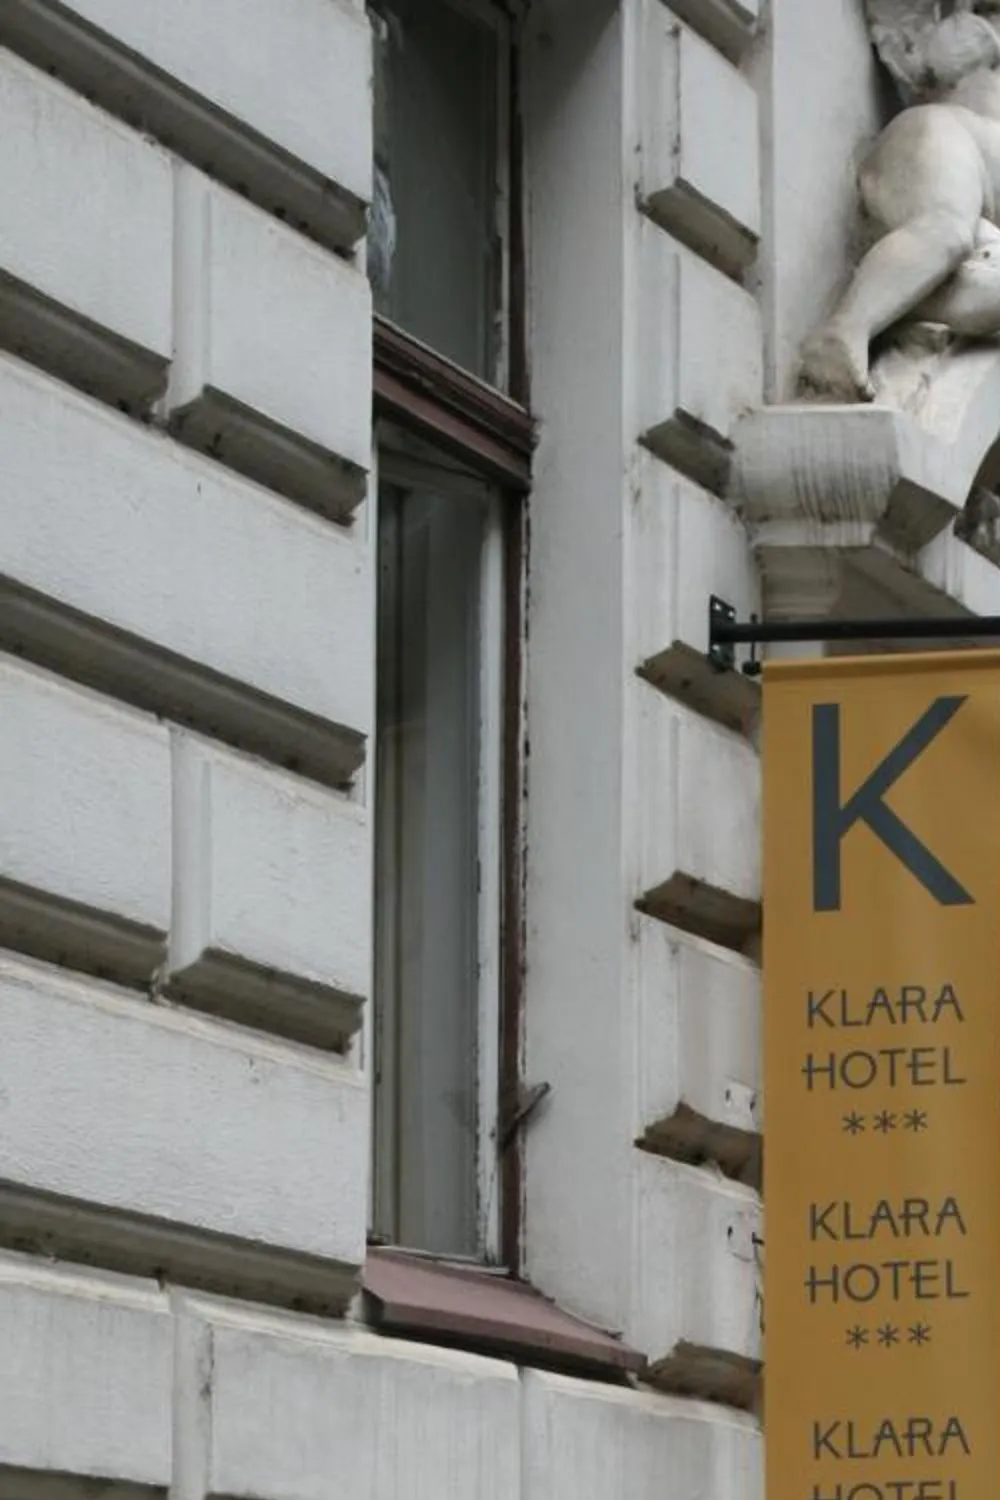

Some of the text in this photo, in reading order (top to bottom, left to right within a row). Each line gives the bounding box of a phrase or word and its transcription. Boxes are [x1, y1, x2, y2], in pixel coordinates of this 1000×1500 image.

[812, 695, 976, 913] K
[807, 984, 964, 1029] KLARA
[802, 1047, 966, 1091] HOTEL
[810, 1198, 967, 1242] KLARA
[804, 1259, 970, 1304] HOTEL
[814, 1417, 971, 1460] KLARA
